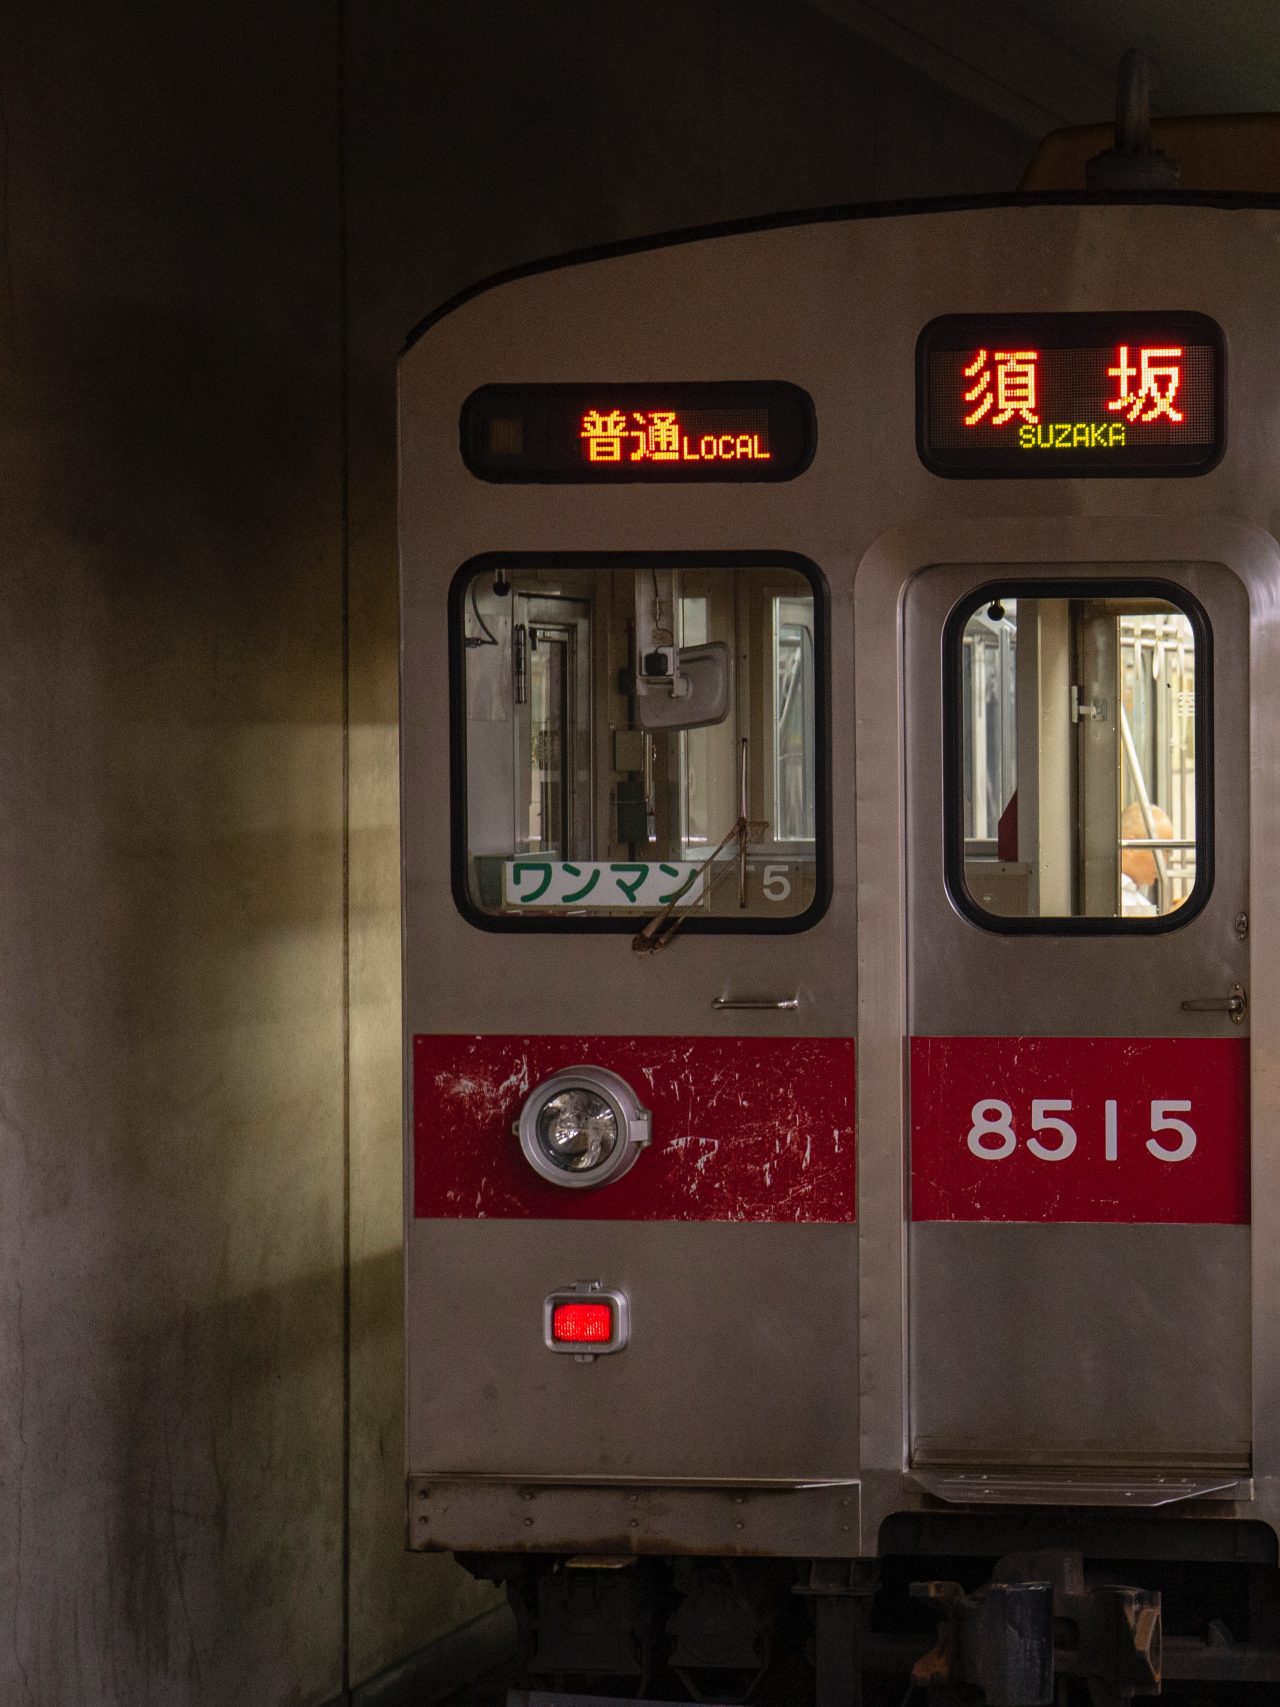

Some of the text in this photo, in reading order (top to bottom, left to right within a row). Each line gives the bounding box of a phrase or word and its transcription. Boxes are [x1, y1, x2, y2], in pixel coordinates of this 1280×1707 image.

[965, 346, 1182, 425] 須坂
[581, 410, 770, 461] 普通 LOCAL
[1019, 423, 1126, 448] SUZAKA
[513, 863, 698, 903] ワンマン
[967, 1099, 1197, 1162] 8515
